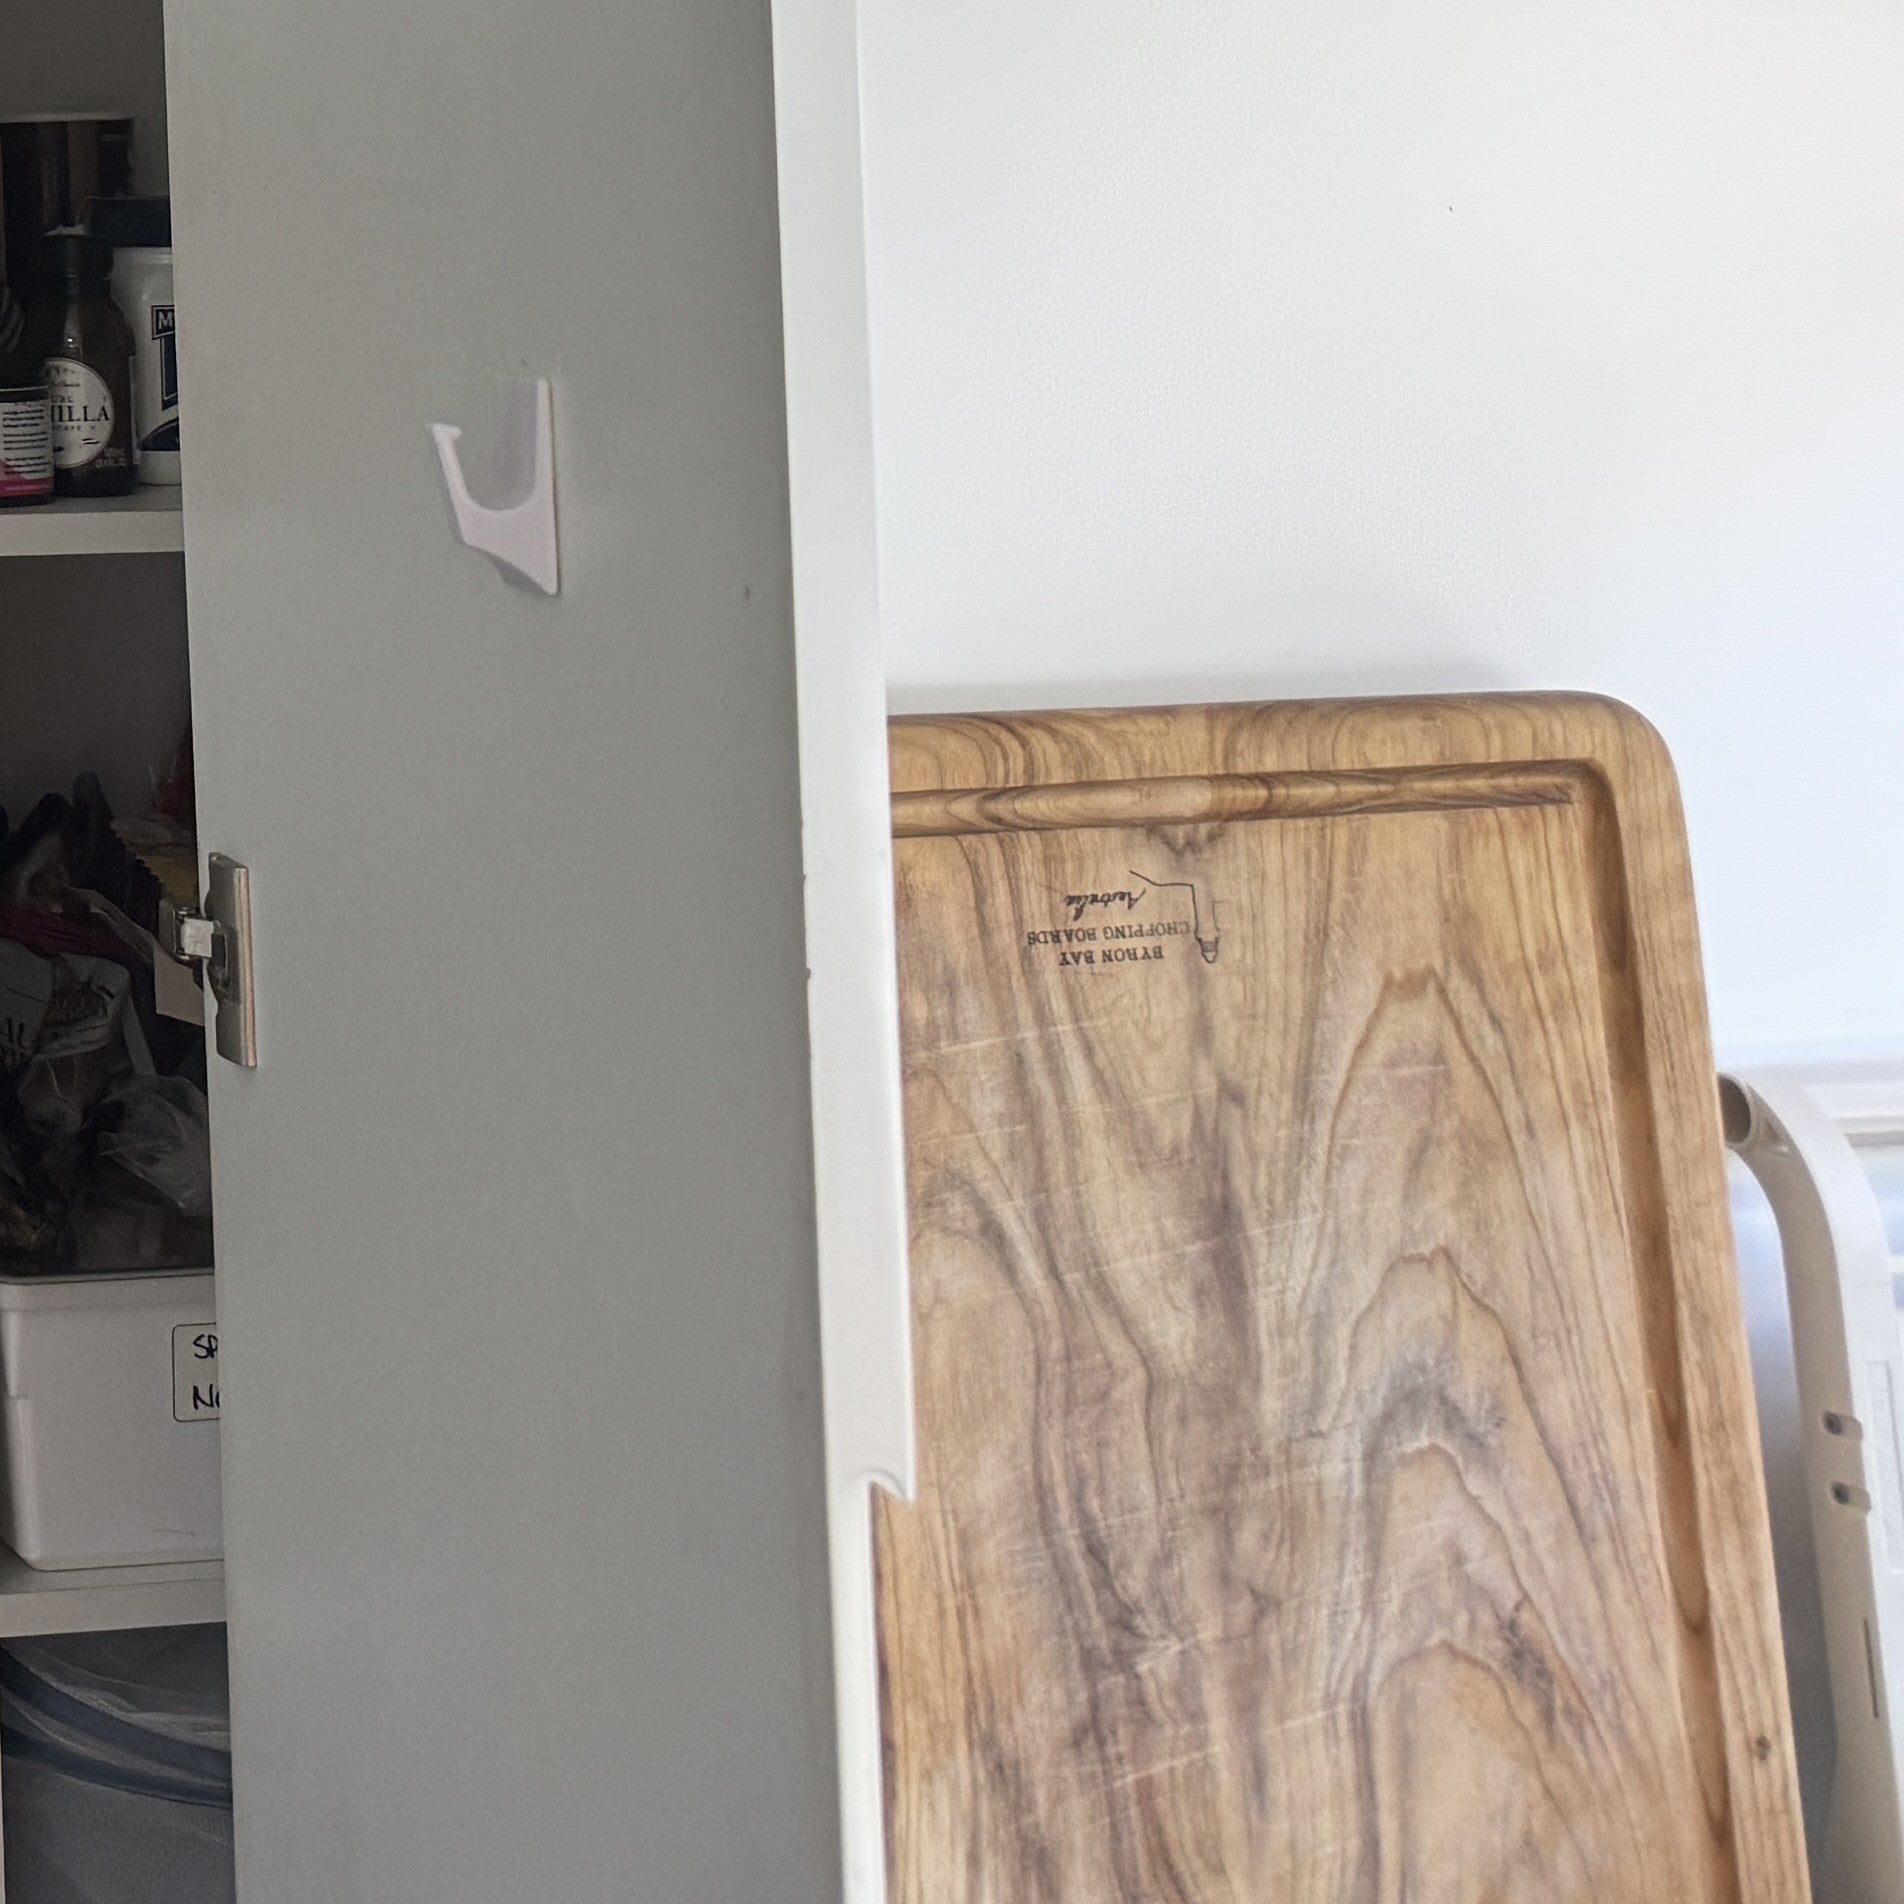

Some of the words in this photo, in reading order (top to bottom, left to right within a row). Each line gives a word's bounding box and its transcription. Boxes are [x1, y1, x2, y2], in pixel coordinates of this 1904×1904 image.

[1027, 928, 1097, 945] BOARDS
[1102, 921, 1191, 941] CHOPPING
[1059, 951, 1095, 966] BAY
[1102, 946, 1164, 963] BYRON
